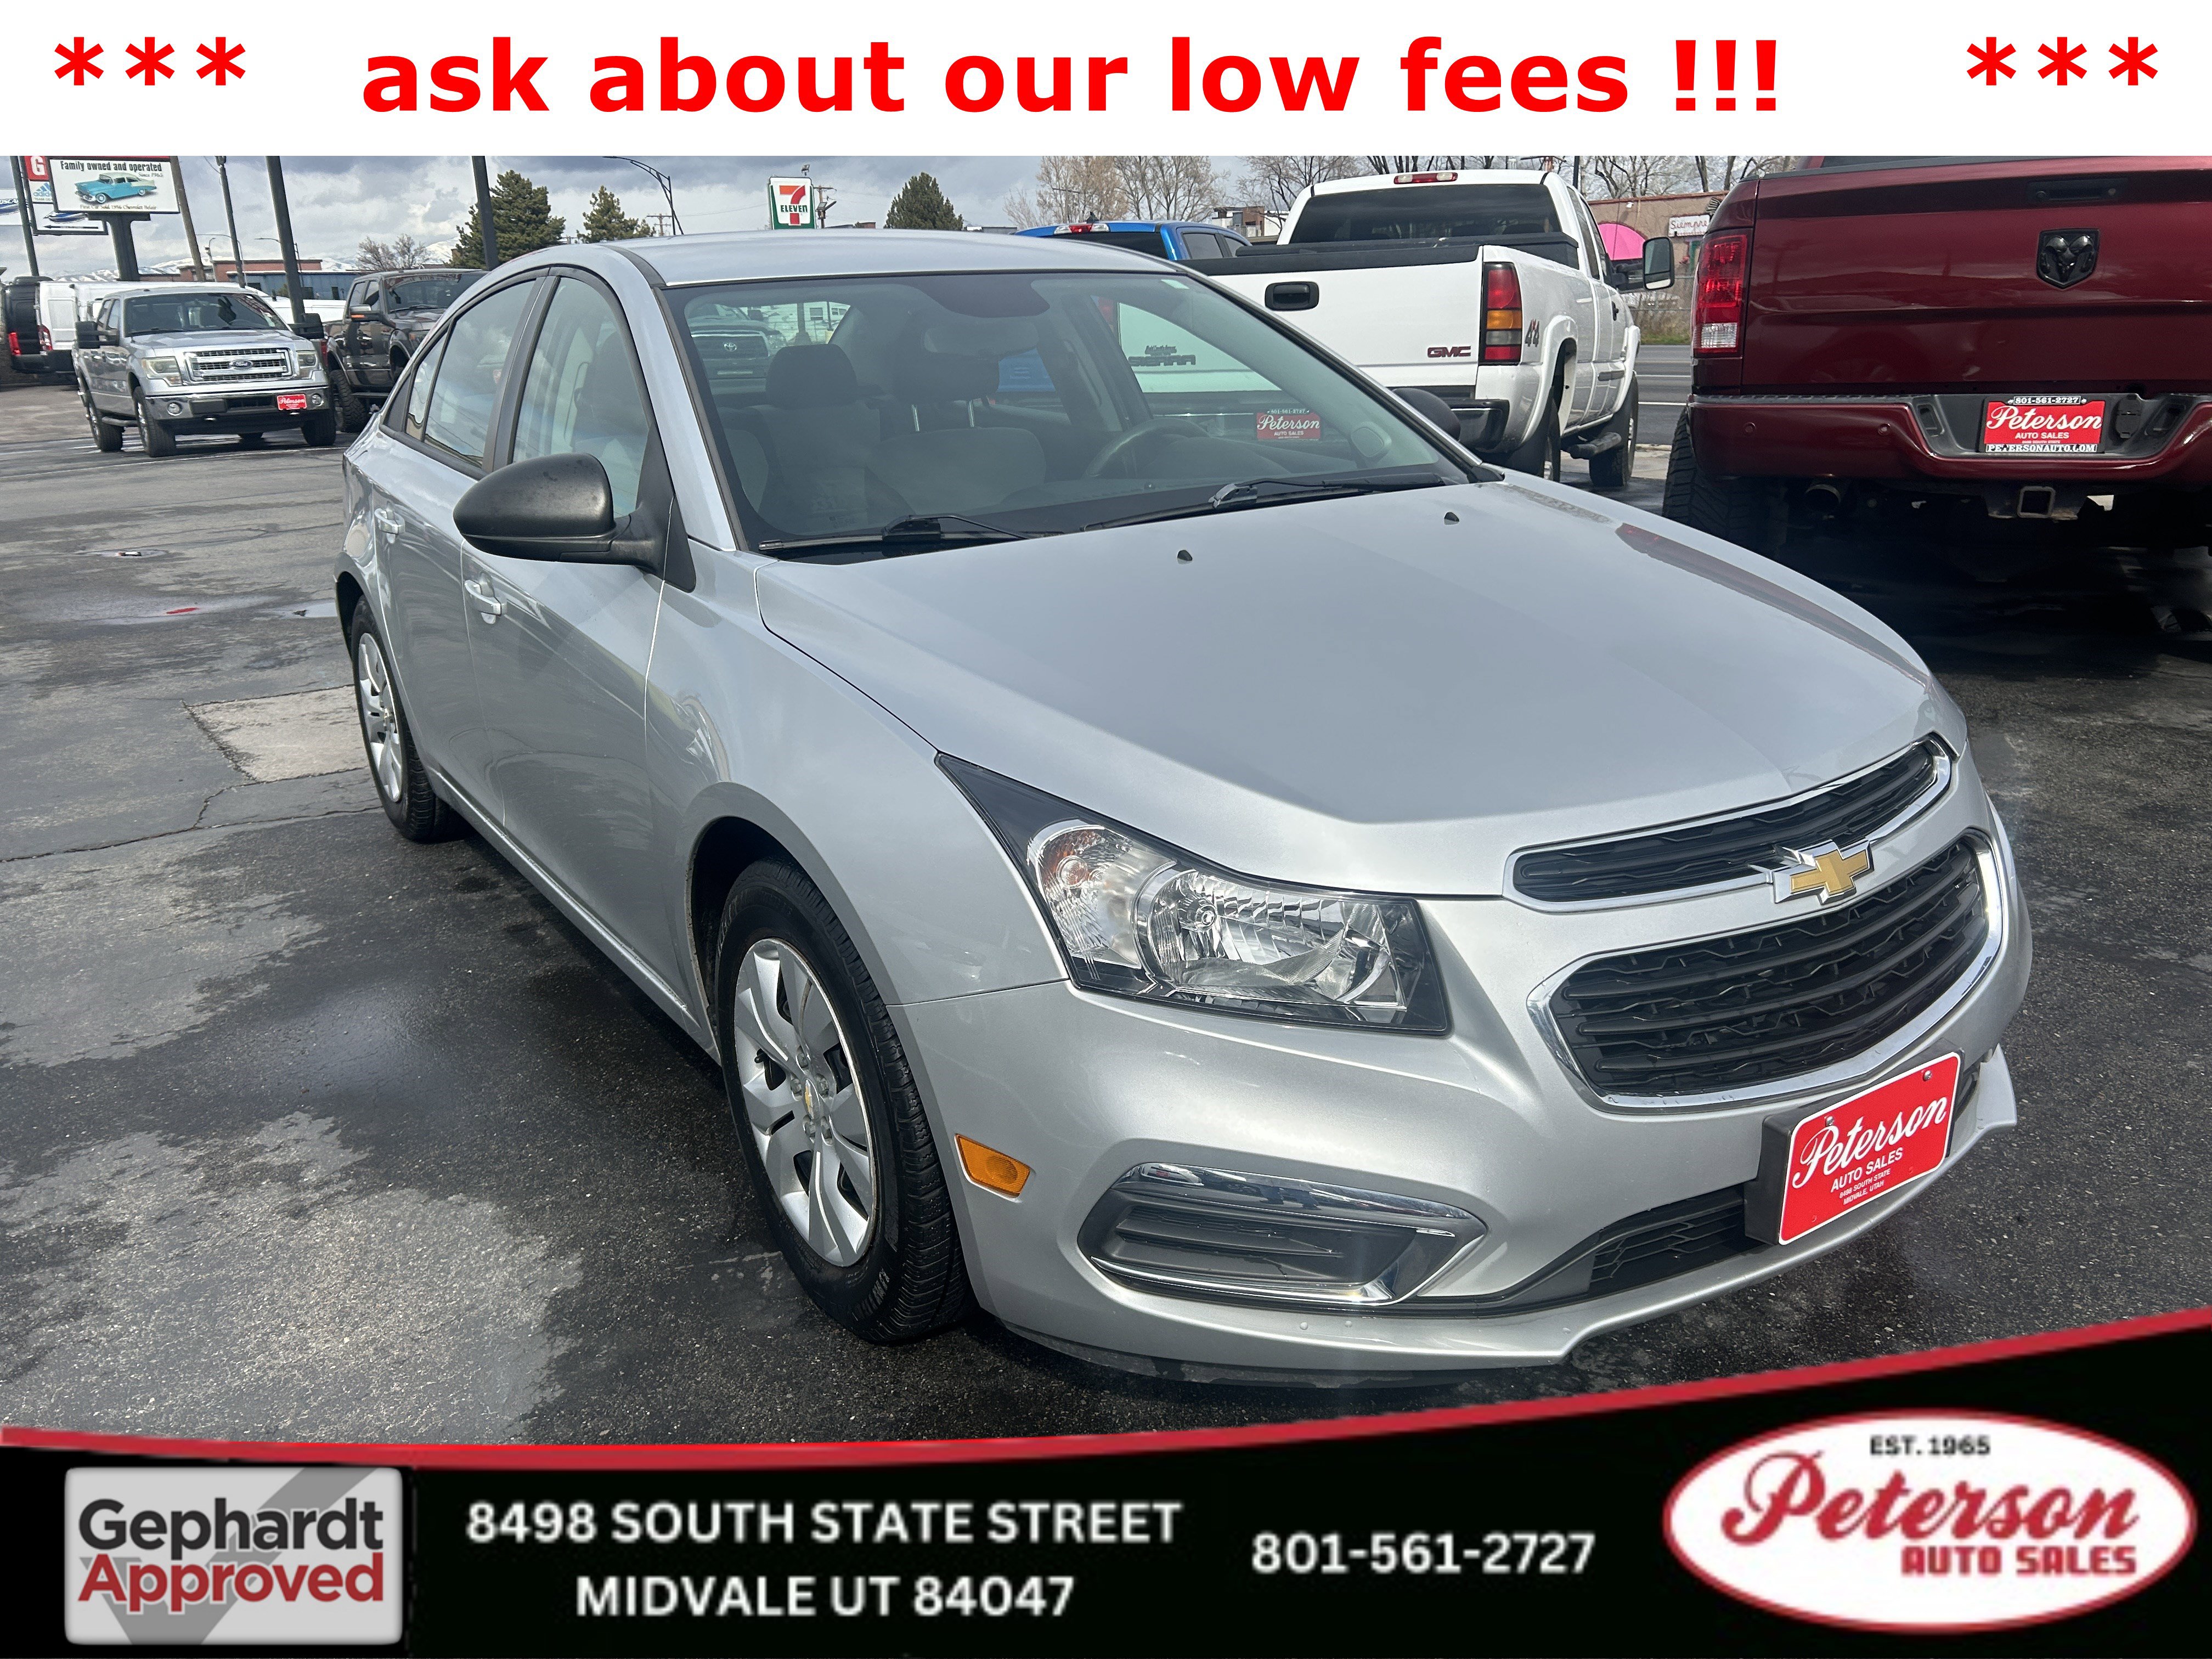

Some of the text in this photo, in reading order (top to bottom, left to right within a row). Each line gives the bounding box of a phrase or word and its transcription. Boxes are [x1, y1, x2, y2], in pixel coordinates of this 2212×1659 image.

[60, 161, 162, 172] Family owned and operated
[779, 185, 805, 224] 7
[1427, 346, 1471, 357] GMC
[1257, 415, 1320, 430] Peterson
[1987, 405, 2102, 430] Peterson
[1792, 1097, 1948, 1188] Peterson
[1830, 1147, 1903, 1193] AUTO SALES
[1853, 1177, 1872, 1192] SOUTH
[1874, 1168, 1891, 1181] STATE
[1870, 1180, 1884, 1192] UTAH
